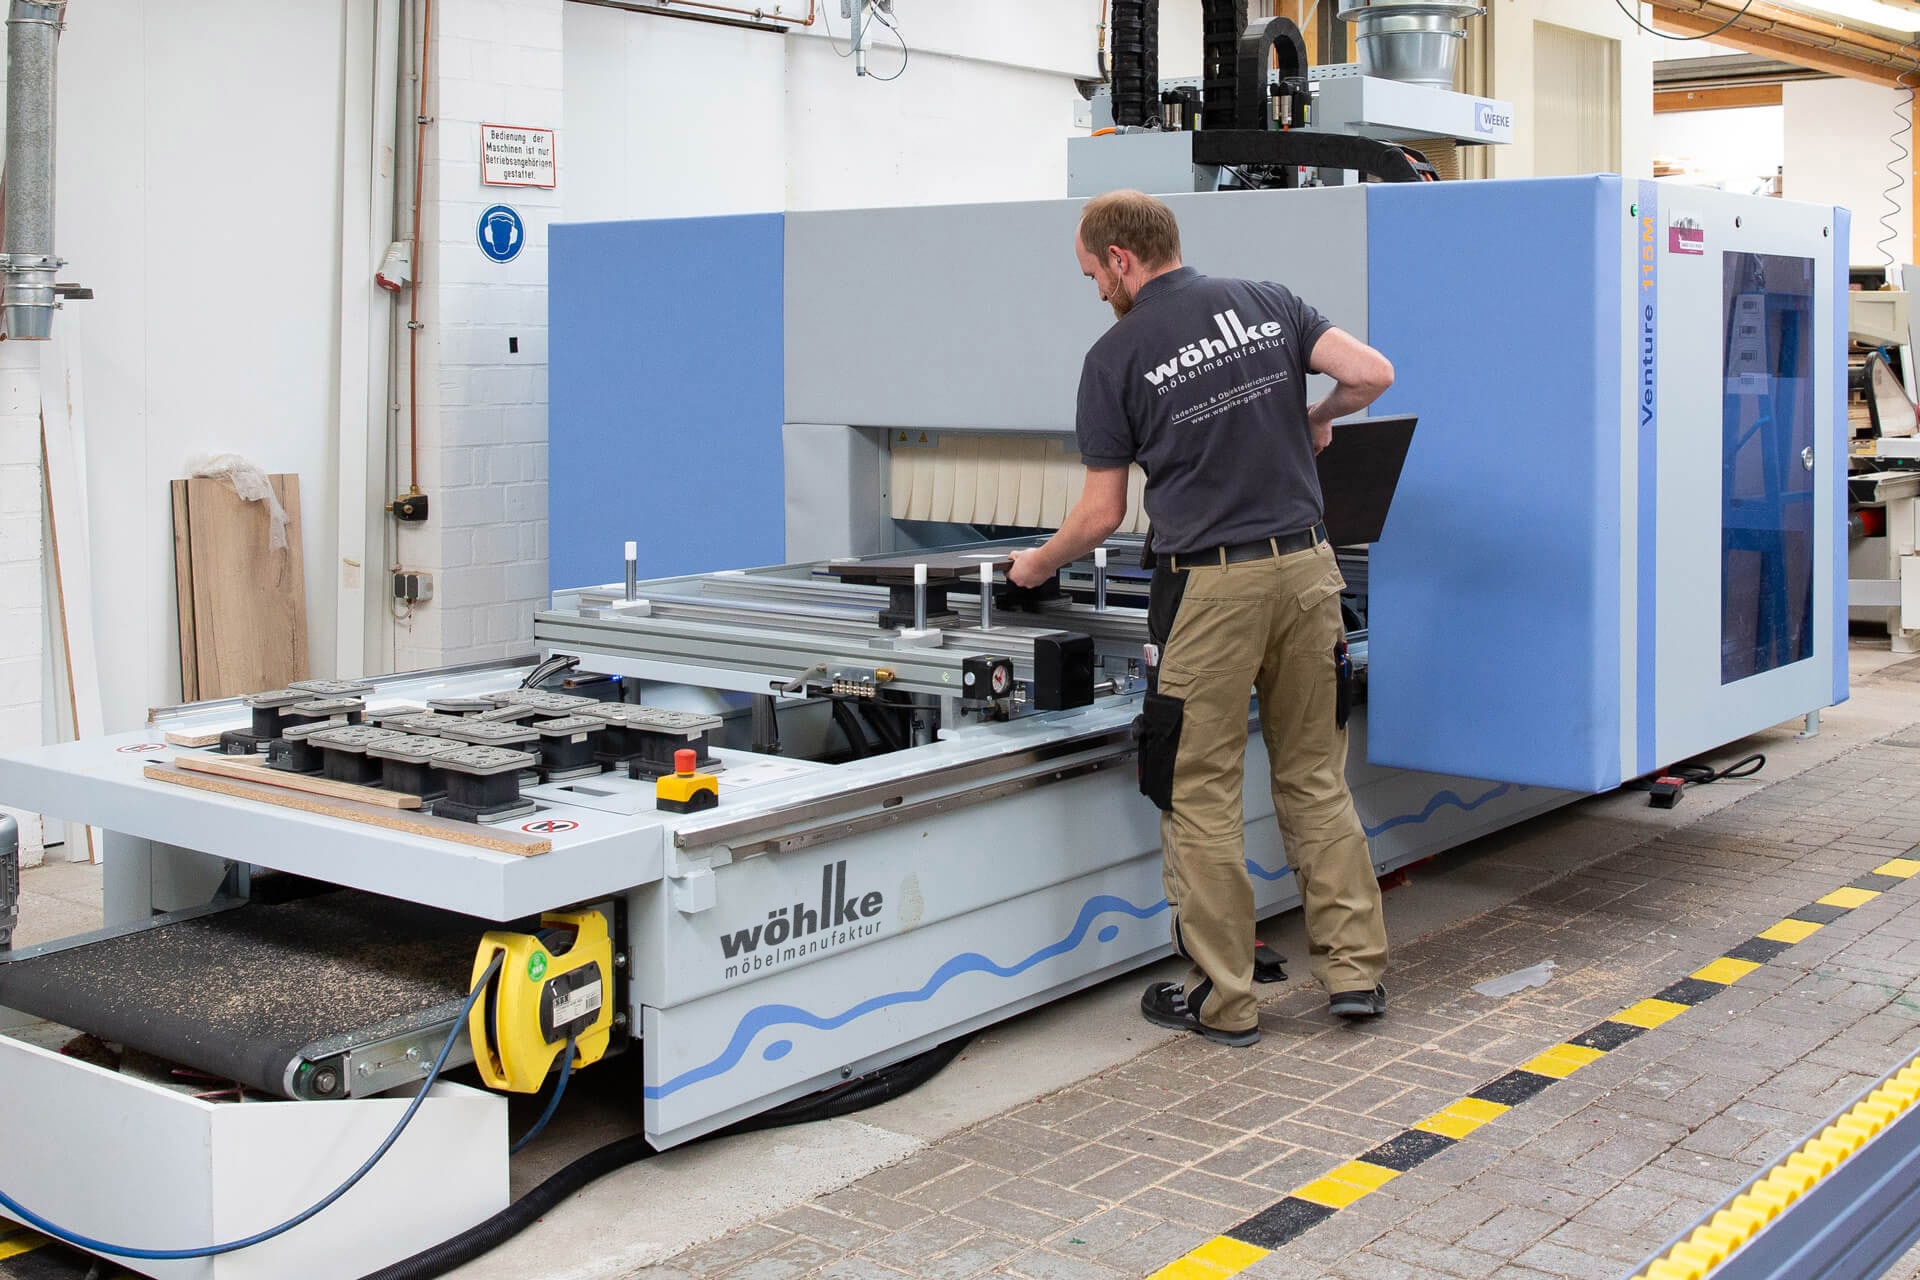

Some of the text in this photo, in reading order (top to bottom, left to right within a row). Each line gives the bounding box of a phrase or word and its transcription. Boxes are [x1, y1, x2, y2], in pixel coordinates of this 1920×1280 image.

[491, 129, 545, 145] Bedienung der
[1484, 112, 1510, 128] WEEKE
[486, 142, 550, 156] Maschinen ist nur
[486, 154, 553, 169] Betriebsangehörigen
[503, 170, 536, 180] gestattet.
[1144, 309, 1282, 386] wöhlke
[1642, 217, 1655, 427] Venture 115M
[1157, 337, 1287, 396] möbelmanufaktur
[1171, 370, 1288, 422] Ladenbau & Objekteinrichtungen
[720, 860, 883, 959] wöhlke
[725, 920, 882, 979] möbelmanufaktur
